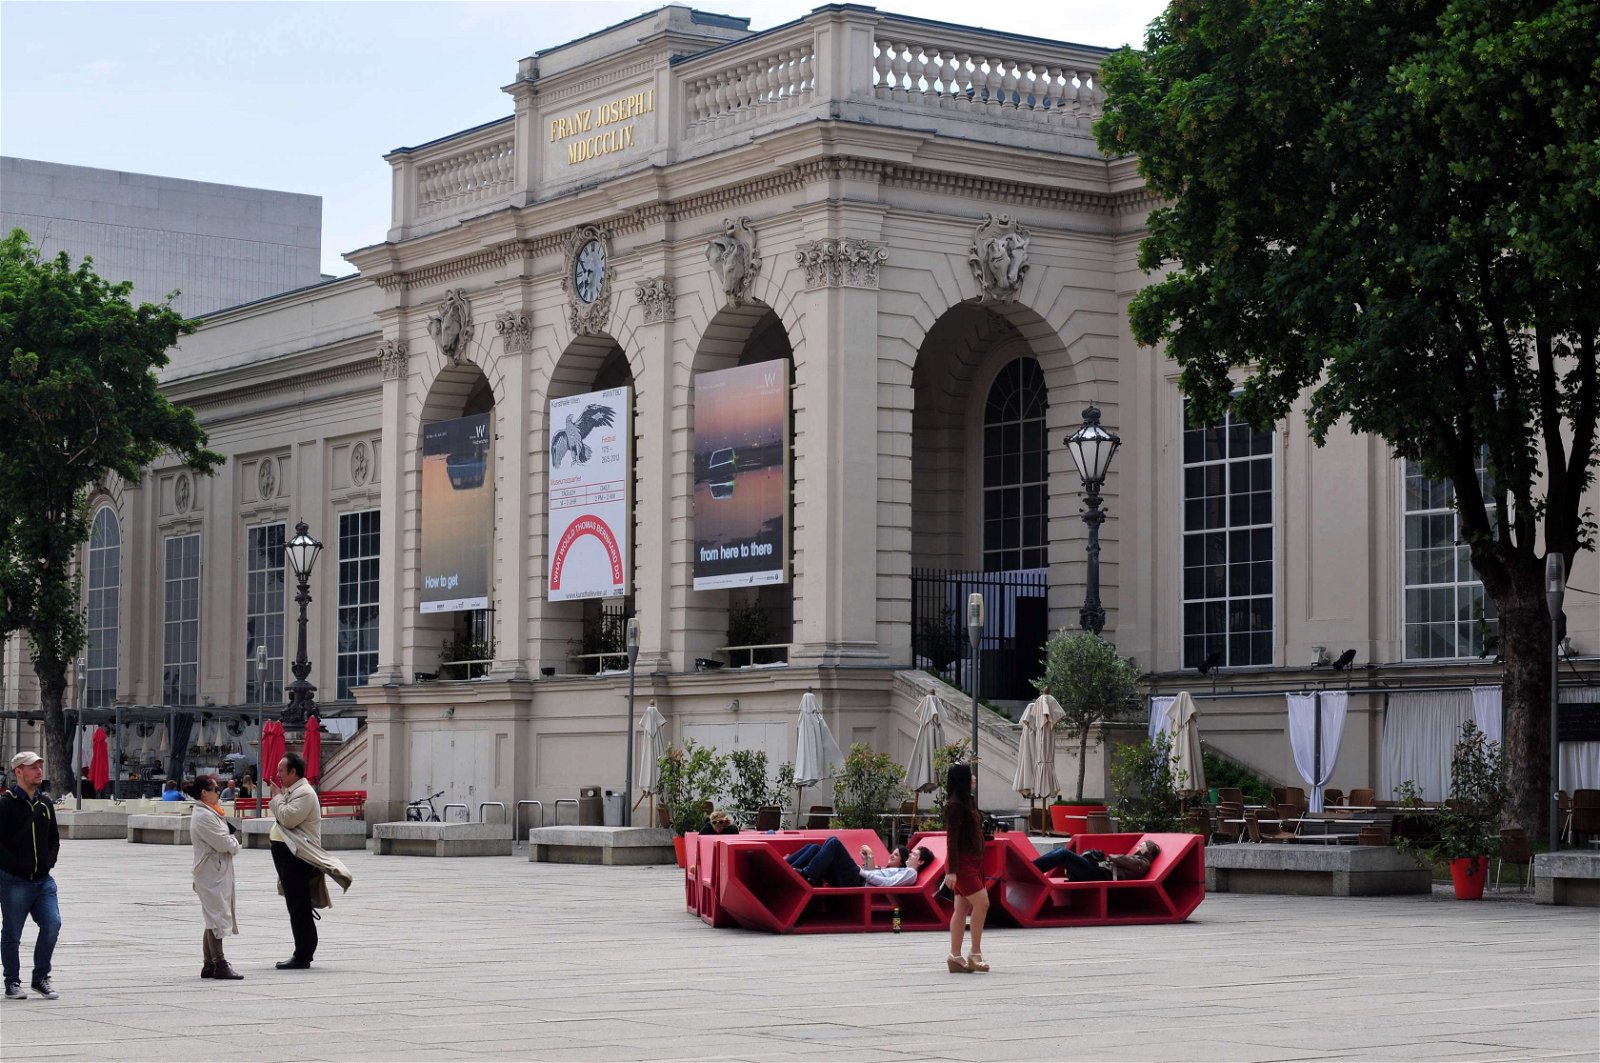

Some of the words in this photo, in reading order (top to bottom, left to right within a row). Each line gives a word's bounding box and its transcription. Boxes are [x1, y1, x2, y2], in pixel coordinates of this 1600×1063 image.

[550, 109, 591, 142] FRANZ
[553, 555, 562, 583] WHAT
[560, 529, 575, 556] WOULD
[574, 520, 597, 533] THOMAS
[596, 524, 618, 563] BERNHARD
[614, 565, 620, 580] DO
[700, 546, 719, 561] from
[720, 545, 739, 560] here
[740, 543, 749, 557] to
[750, 541, 773, 556] there
[425, 575, 440, 589] How
[440, 575, 447, 588] to
[447, 573, 459, 590] get
